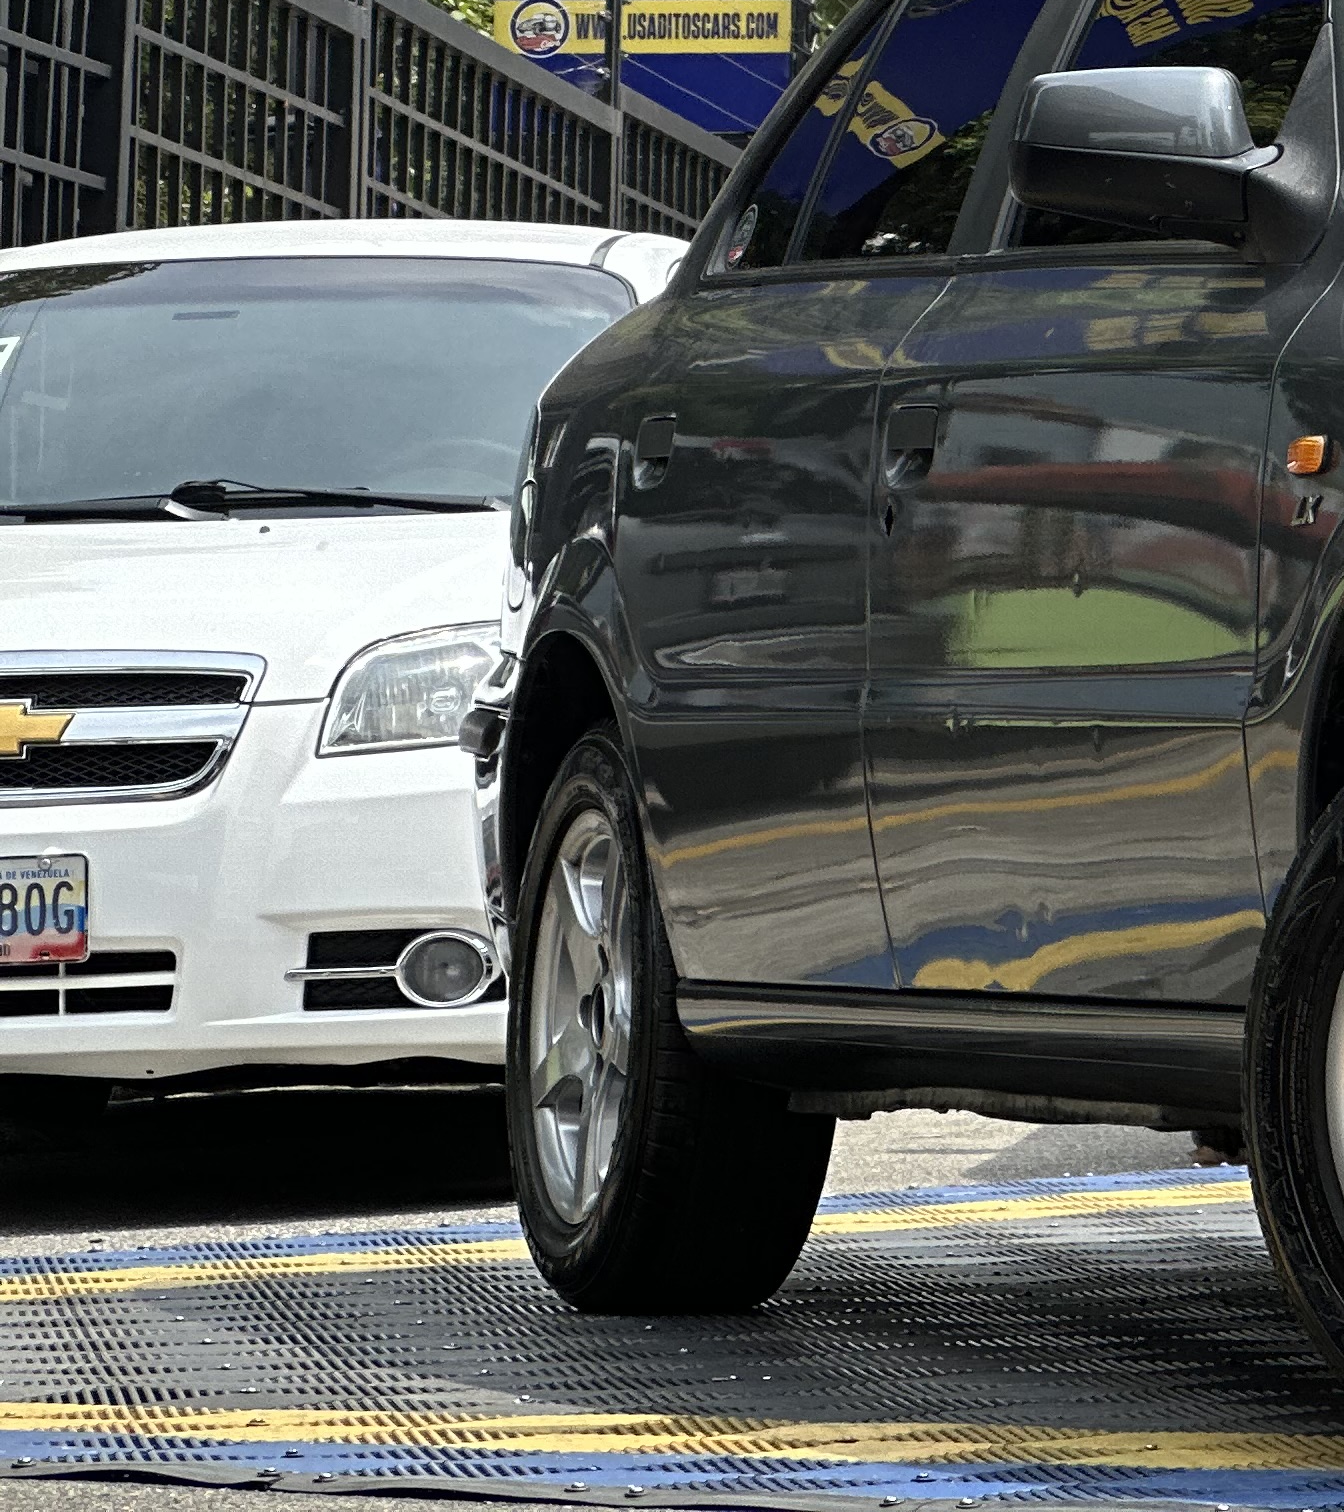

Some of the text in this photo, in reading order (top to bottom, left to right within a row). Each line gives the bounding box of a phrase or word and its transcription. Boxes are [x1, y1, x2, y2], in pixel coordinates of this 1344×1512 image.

[575, 12, 780, 40] WW.USADITOSCARS.COM
[1290, 495, 1322, 526] LX
[6, 870, 17, 880] DE
[20, 868, 70, 880] VENEZUELA
